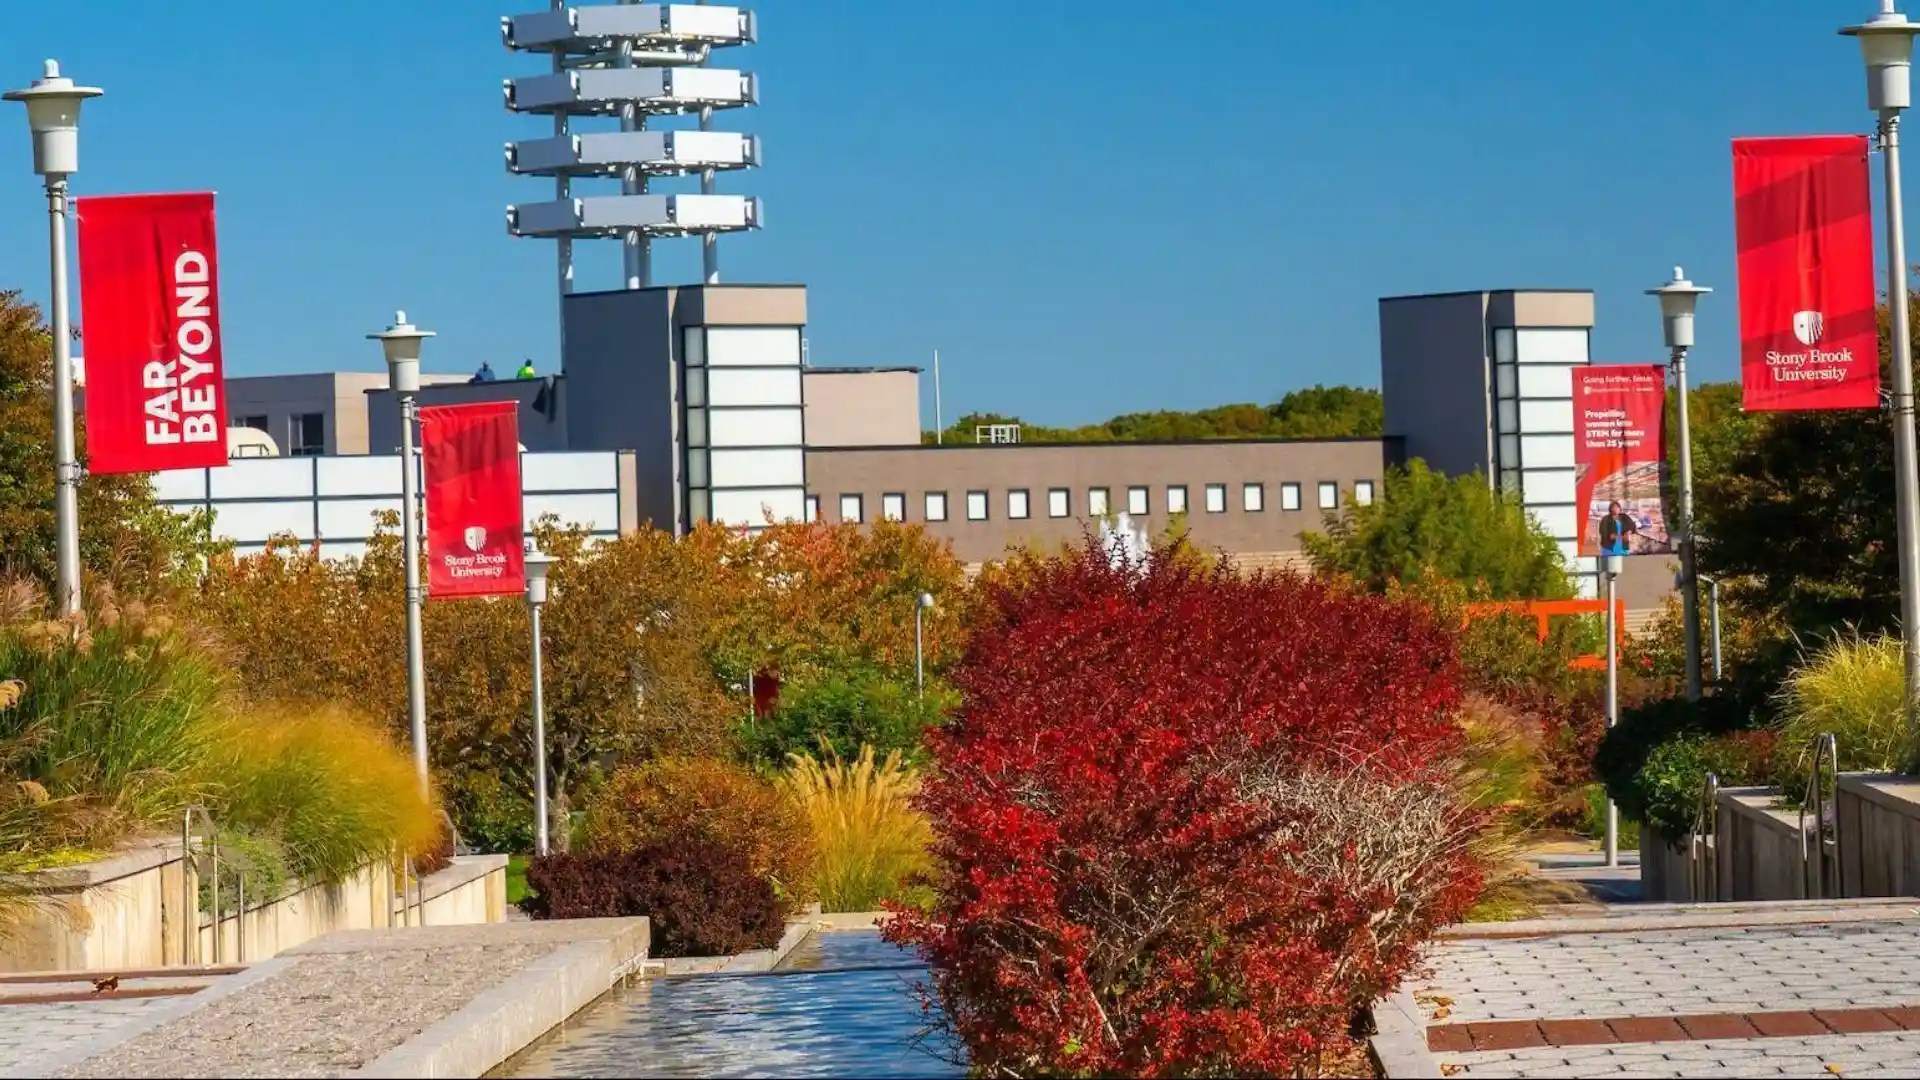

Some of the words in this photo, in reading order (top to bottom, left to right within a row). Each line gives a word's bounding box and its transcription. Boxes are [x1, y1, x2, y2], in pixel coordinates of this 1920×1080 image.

[175, 251, 218, 442] BEYOND
[1766, 351, 1807, 367] Stony
[1809, 347, 1853, 363] Brook
[1773, 366, 1847, 382] University
[143, 360, 181, 444] FAR
[1585, 429, 1610, 438] STEM
[1611, 429, 1623, 437] for
[444, 555, 475, 567] Stony
[476, 552, 507, 564] Brook
[451, 566, 503, 578] University
